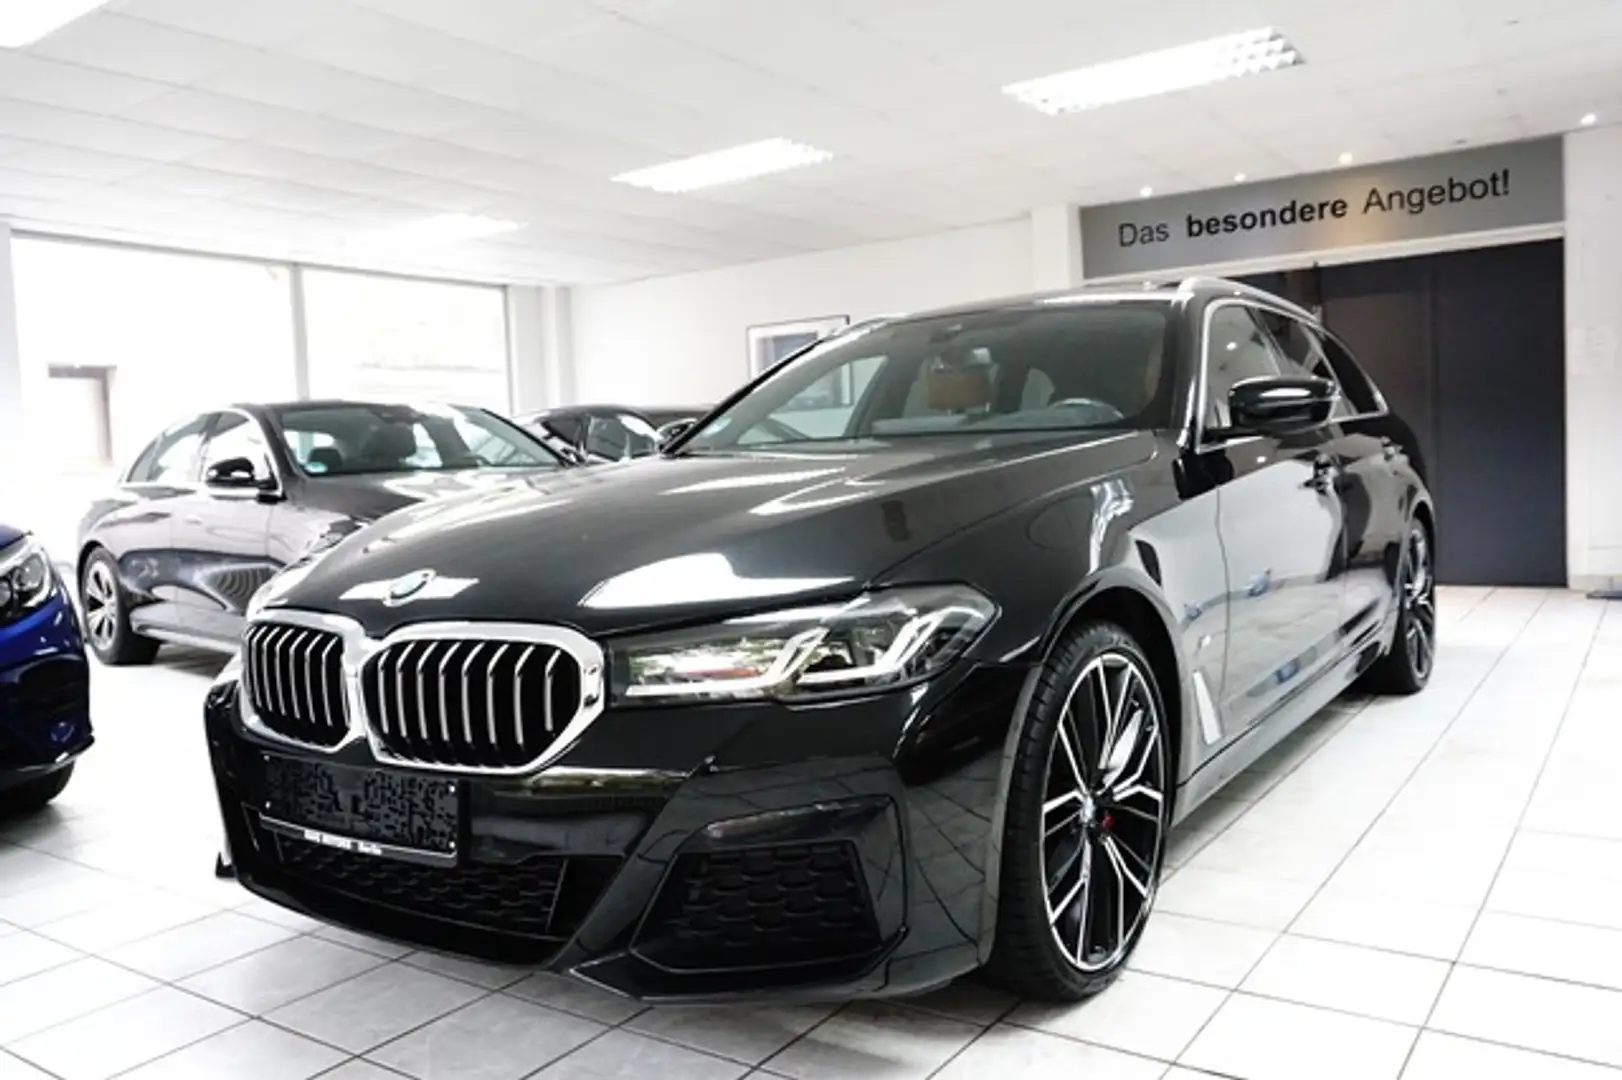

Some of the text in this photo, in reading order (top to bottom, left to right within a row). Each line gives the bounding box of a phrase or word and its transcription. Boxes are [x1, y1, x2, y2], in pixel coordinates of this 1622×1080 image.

[1118, 168, 1510, 248] Das besondere Angebot!
